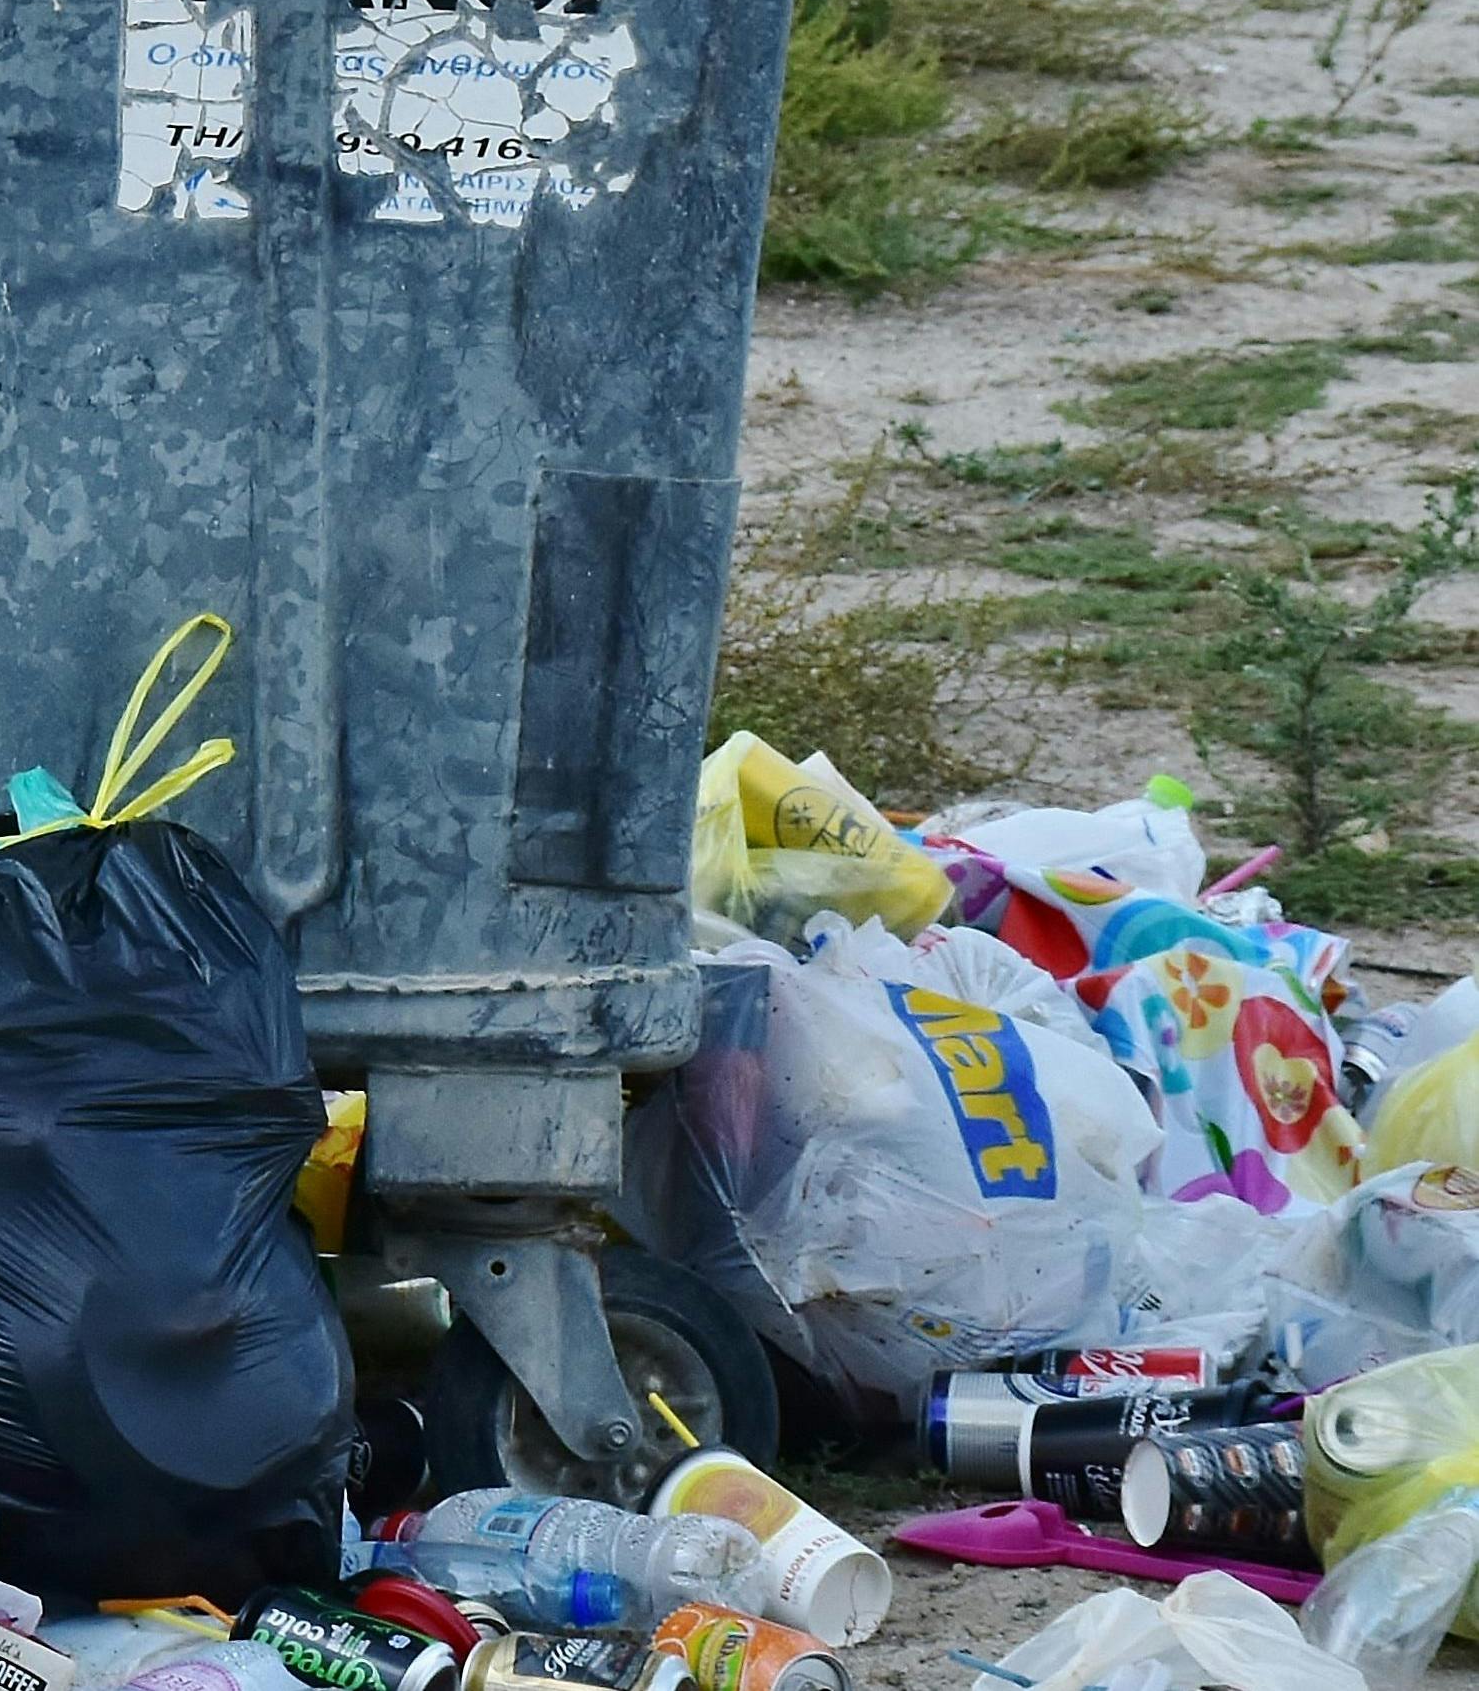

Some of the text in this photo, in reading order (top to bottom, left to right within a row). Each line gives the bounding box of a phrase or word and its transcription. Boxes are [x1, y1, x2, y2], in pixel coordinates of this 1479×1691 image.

[191, 43, 248, 68] δικ
[336, 54, 387, 78] ας
[267, 1608, 325, 1643] cola
